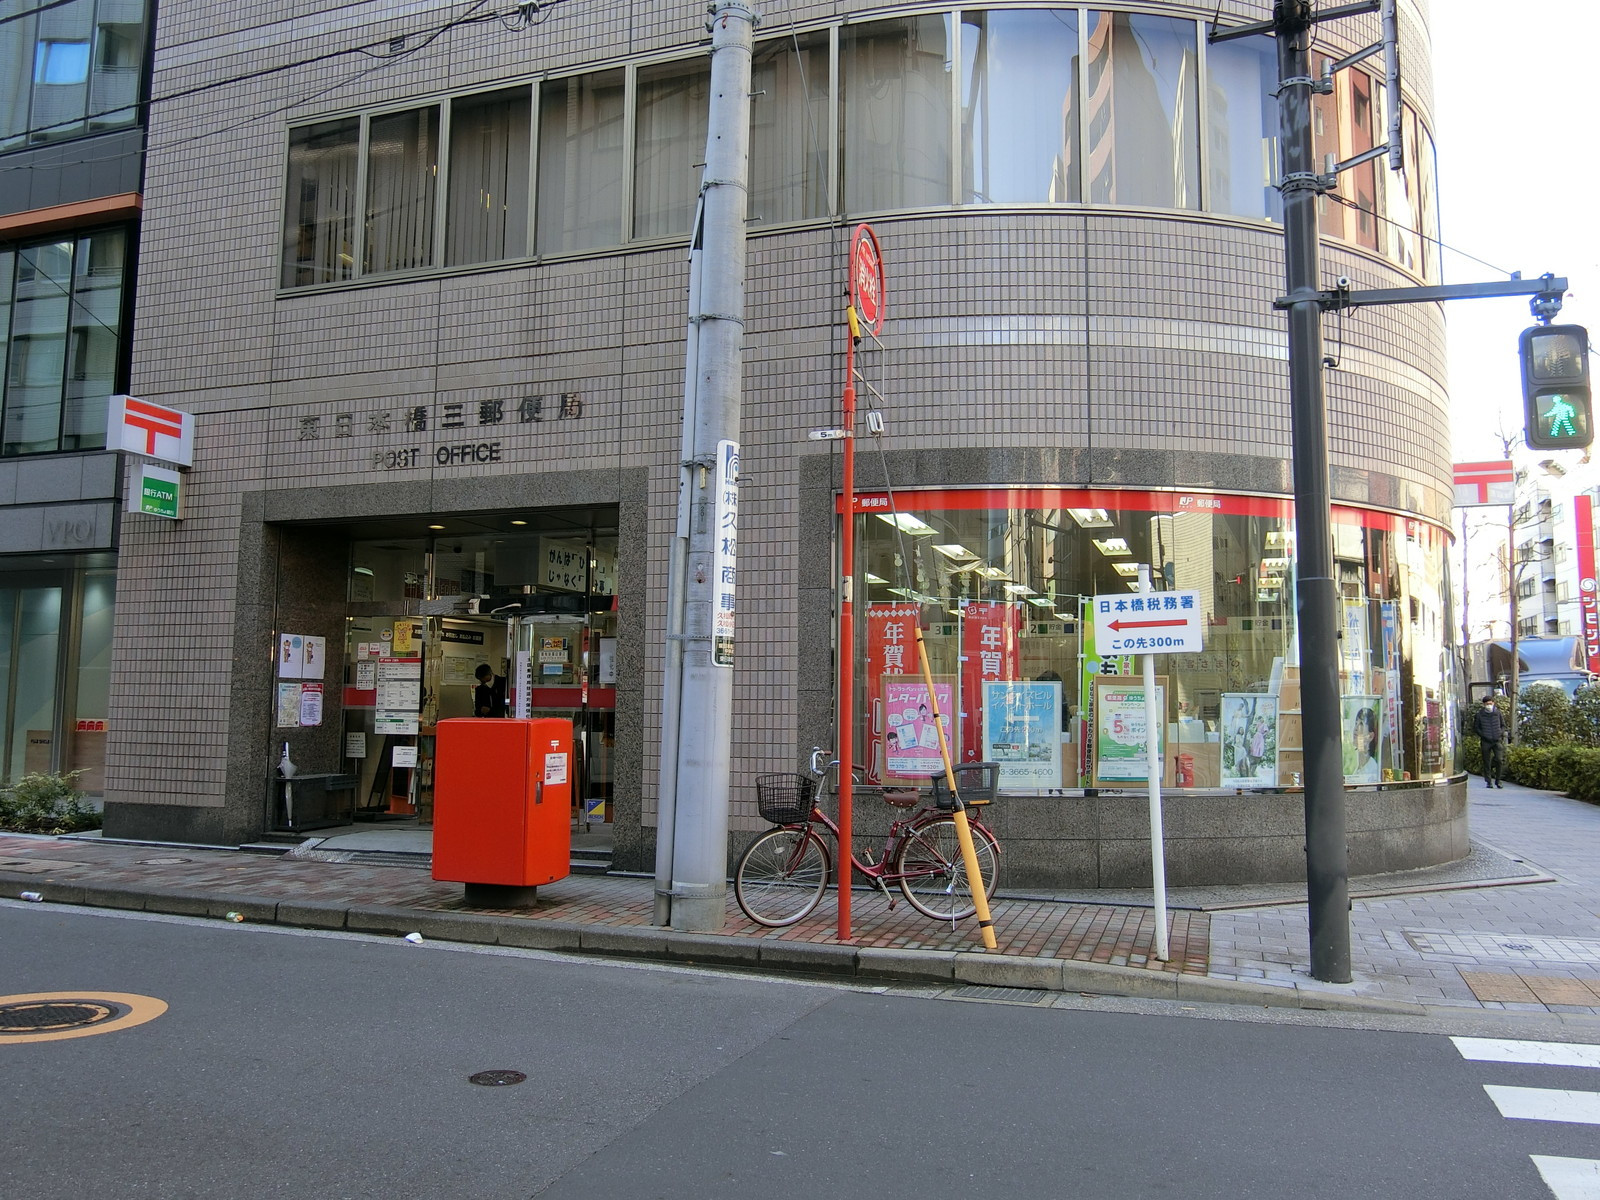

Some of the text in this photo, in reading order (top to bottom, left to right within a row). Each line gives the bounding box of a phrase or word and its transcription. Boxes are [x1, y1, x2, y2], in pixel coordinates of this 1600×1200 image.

[299, 393, 583, 440] 東日本橋三郵便局
[371, 442, 500, 469] POST OFFICE
[143, 487, 173, 501] 銀行ATM
[861, 497, 888, 507] 郵便局
[1196, 498, 1221, 508] 郵便局
[1100, 595, 1194, 613] 日本橋税務署
[1030, 624, 1037, 634] 2
[883, 622, 904, 675] 年賀
[1112, 637, 1185, 650] この先300m
[980, 625, 1002, 681] 年賀
[888, 693, 949, 704] レターパク
[1000, 768, 1053, 776] 3-3665-4600
